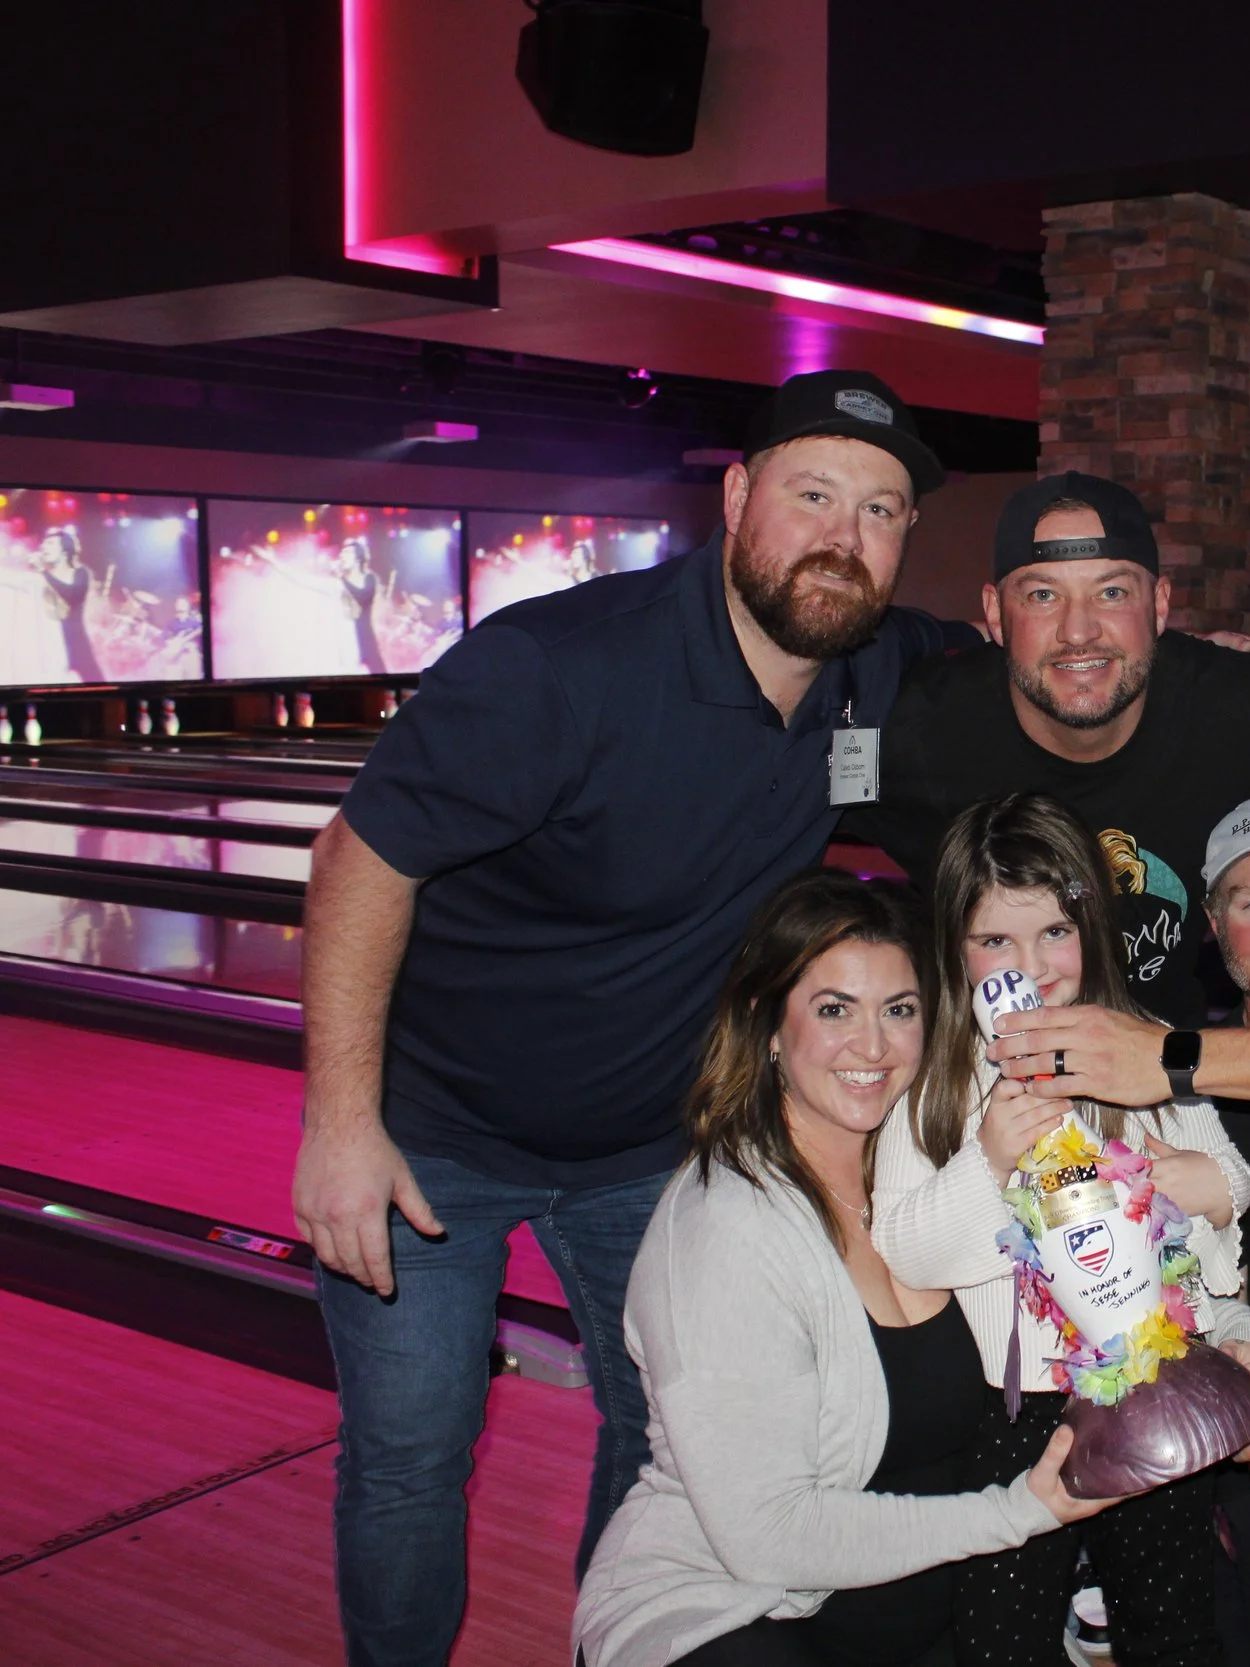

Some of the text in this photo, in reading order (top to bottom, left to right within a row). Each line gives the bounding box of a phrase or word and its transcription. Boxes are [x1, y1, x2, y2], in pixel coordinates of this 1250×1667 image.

[982, 970, 1024, 1005] DP
[1078, 1267, 1133, 1299] IN HONOR OF
[1090, 1288, 1120, 1308] JESSE
[1108, 1279, 1151, 1309] JENNINGS
